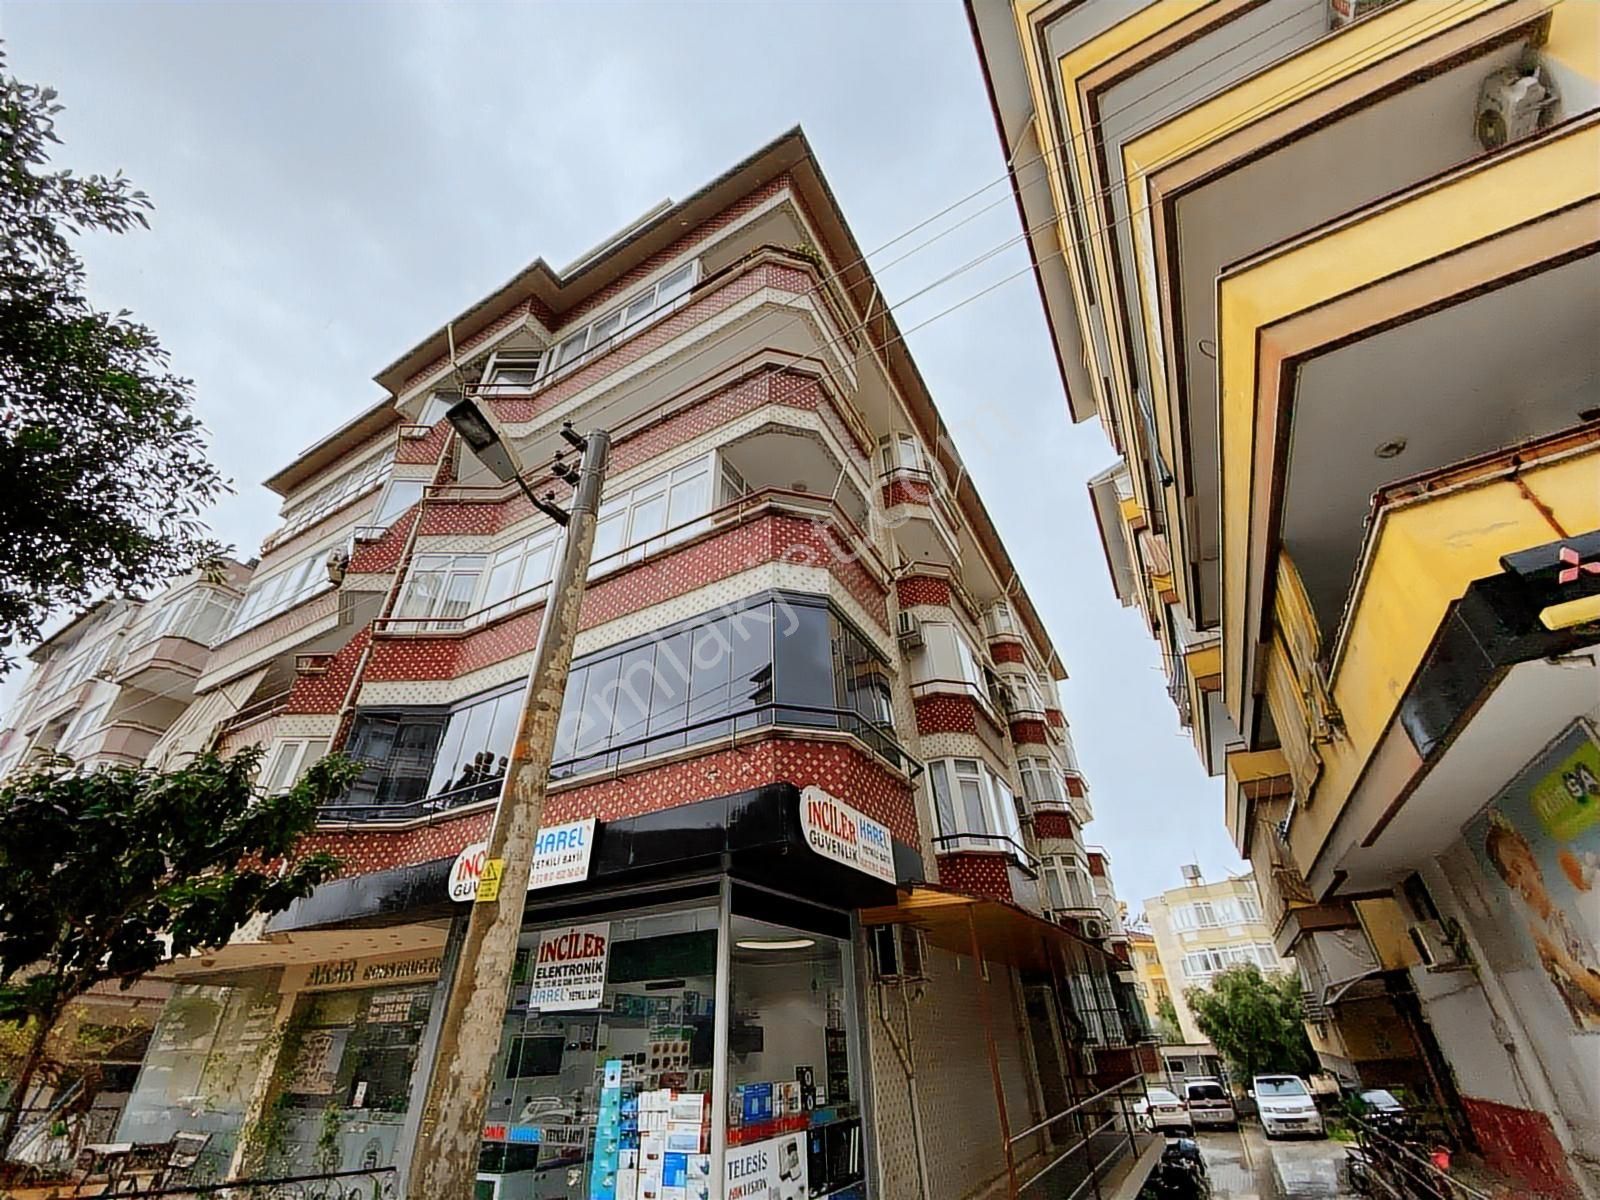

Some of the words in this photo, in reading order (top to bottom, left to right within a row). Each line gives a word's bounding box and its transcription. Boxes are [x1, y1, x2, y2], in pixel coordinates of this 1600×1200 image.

[809, 829, 859, 864] GÜVENLİK
[536, 959, 603, 979] ELEKTRONİK
[728, 1149, 768, 1180] TELESİS
